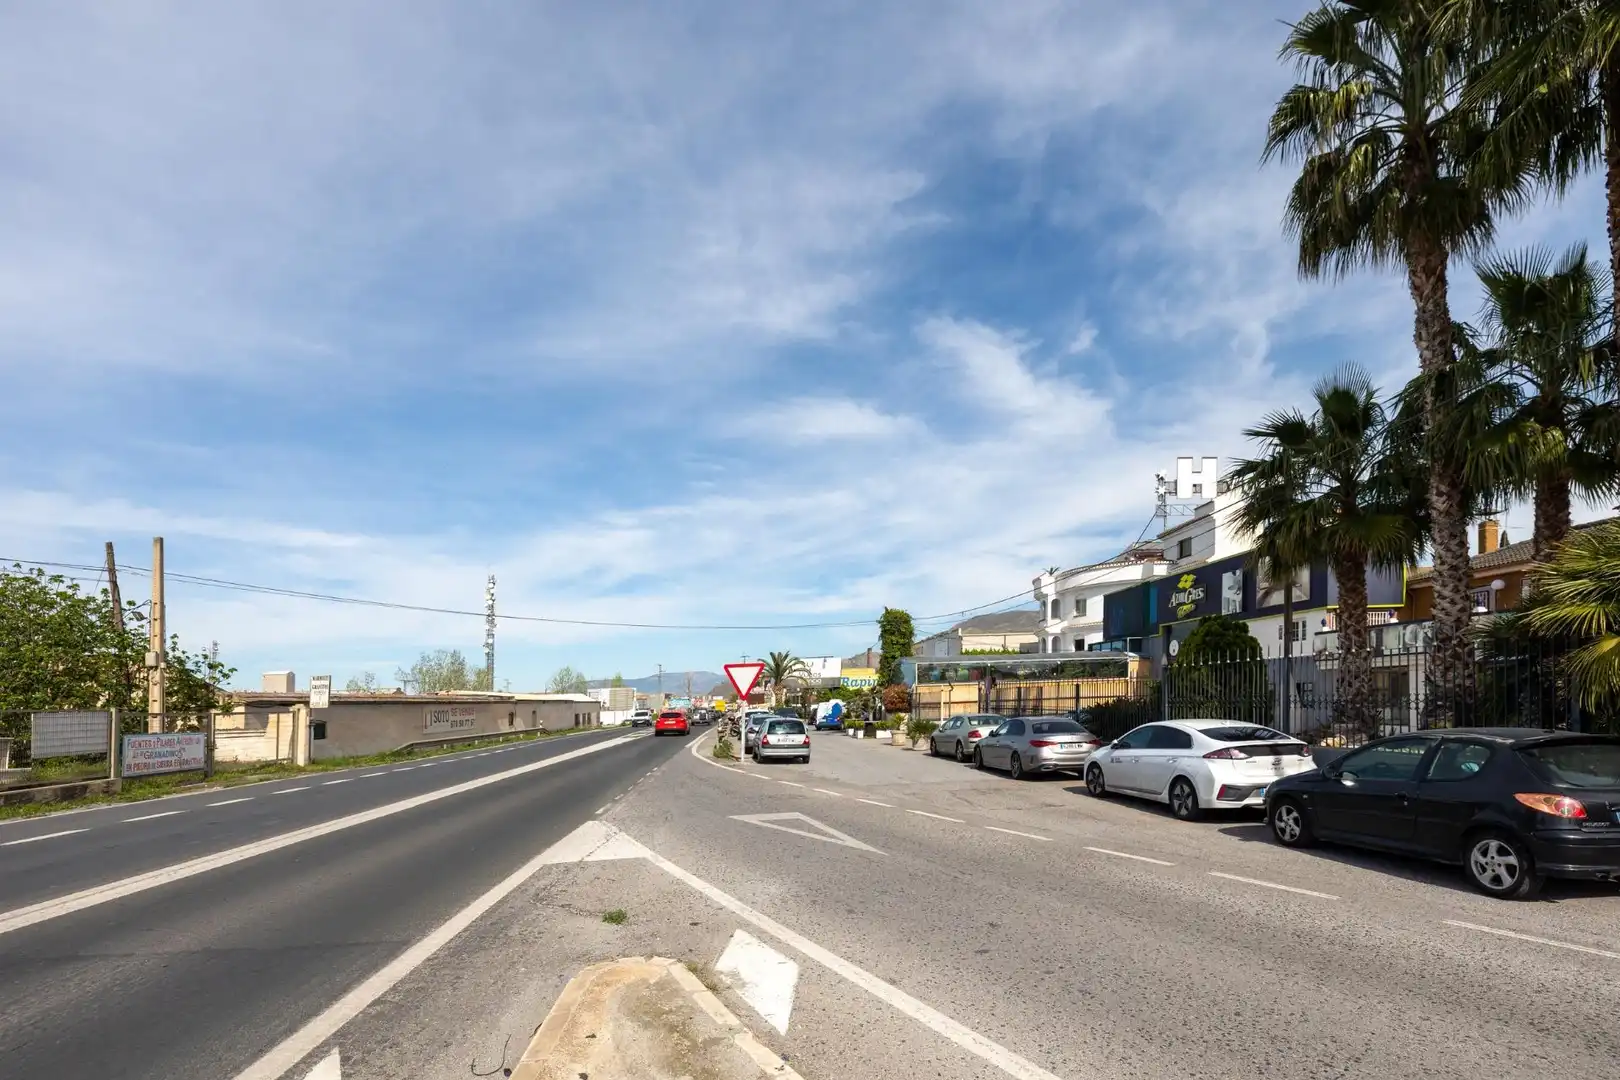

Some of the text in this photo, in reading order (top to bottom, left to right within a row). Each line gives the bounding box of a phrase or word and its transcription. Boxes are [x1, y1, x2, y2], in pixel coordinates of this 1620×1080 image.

[1177, 457, 1217, 499] H
[434, 709, 450, 723] SOTO
[127, 739, 152, 749] FUENTES
